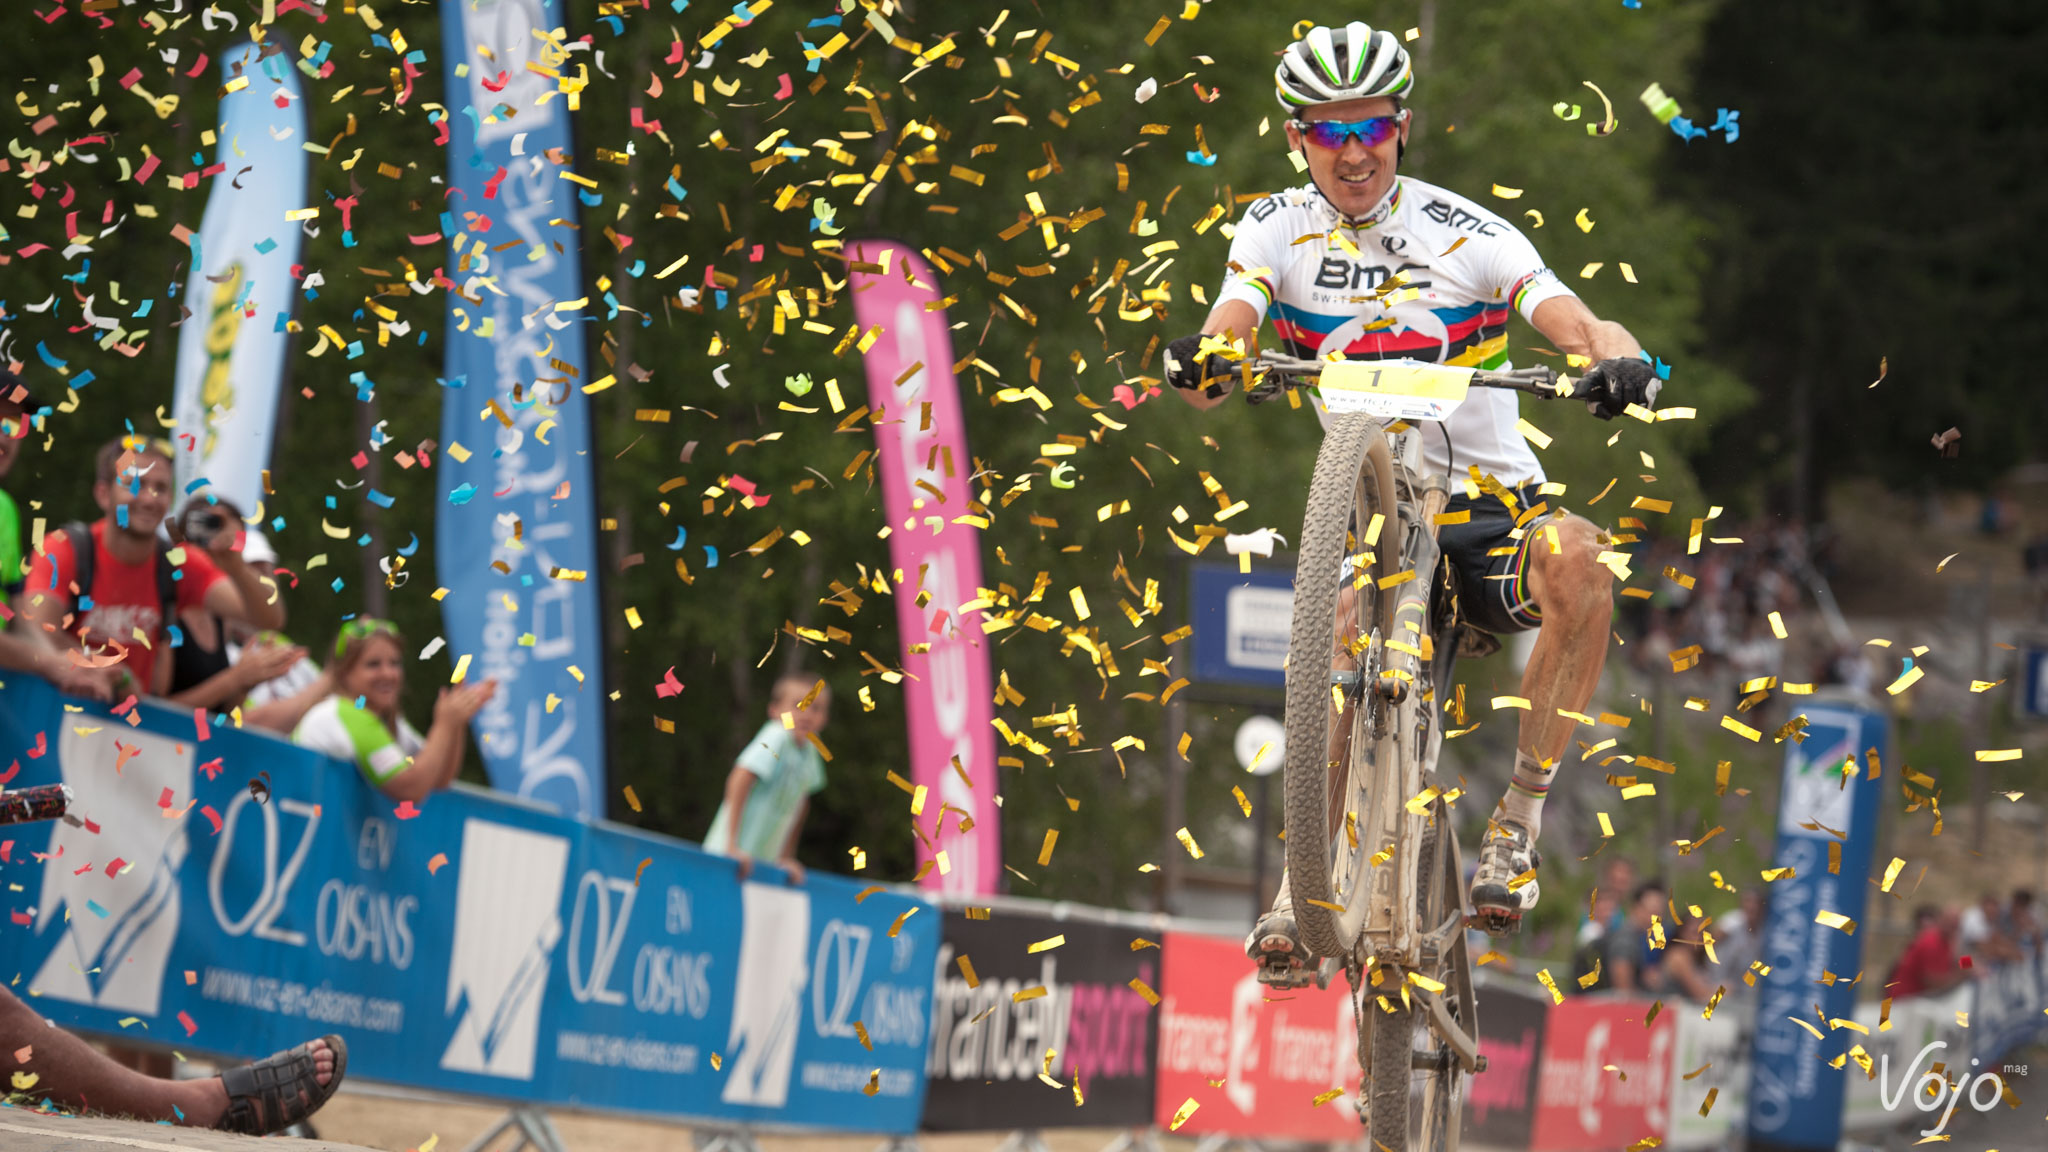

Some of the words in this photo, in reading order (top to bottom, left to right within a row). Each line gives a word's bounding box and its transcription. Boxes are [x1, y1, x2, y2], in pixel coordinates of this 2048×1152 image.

[1314, 256, 1432, 290] BMC
[1367, 369, 1383, 387] 1
[208, 786, 322, 947] OZ
[567, 869, 639, 1005] OZ
